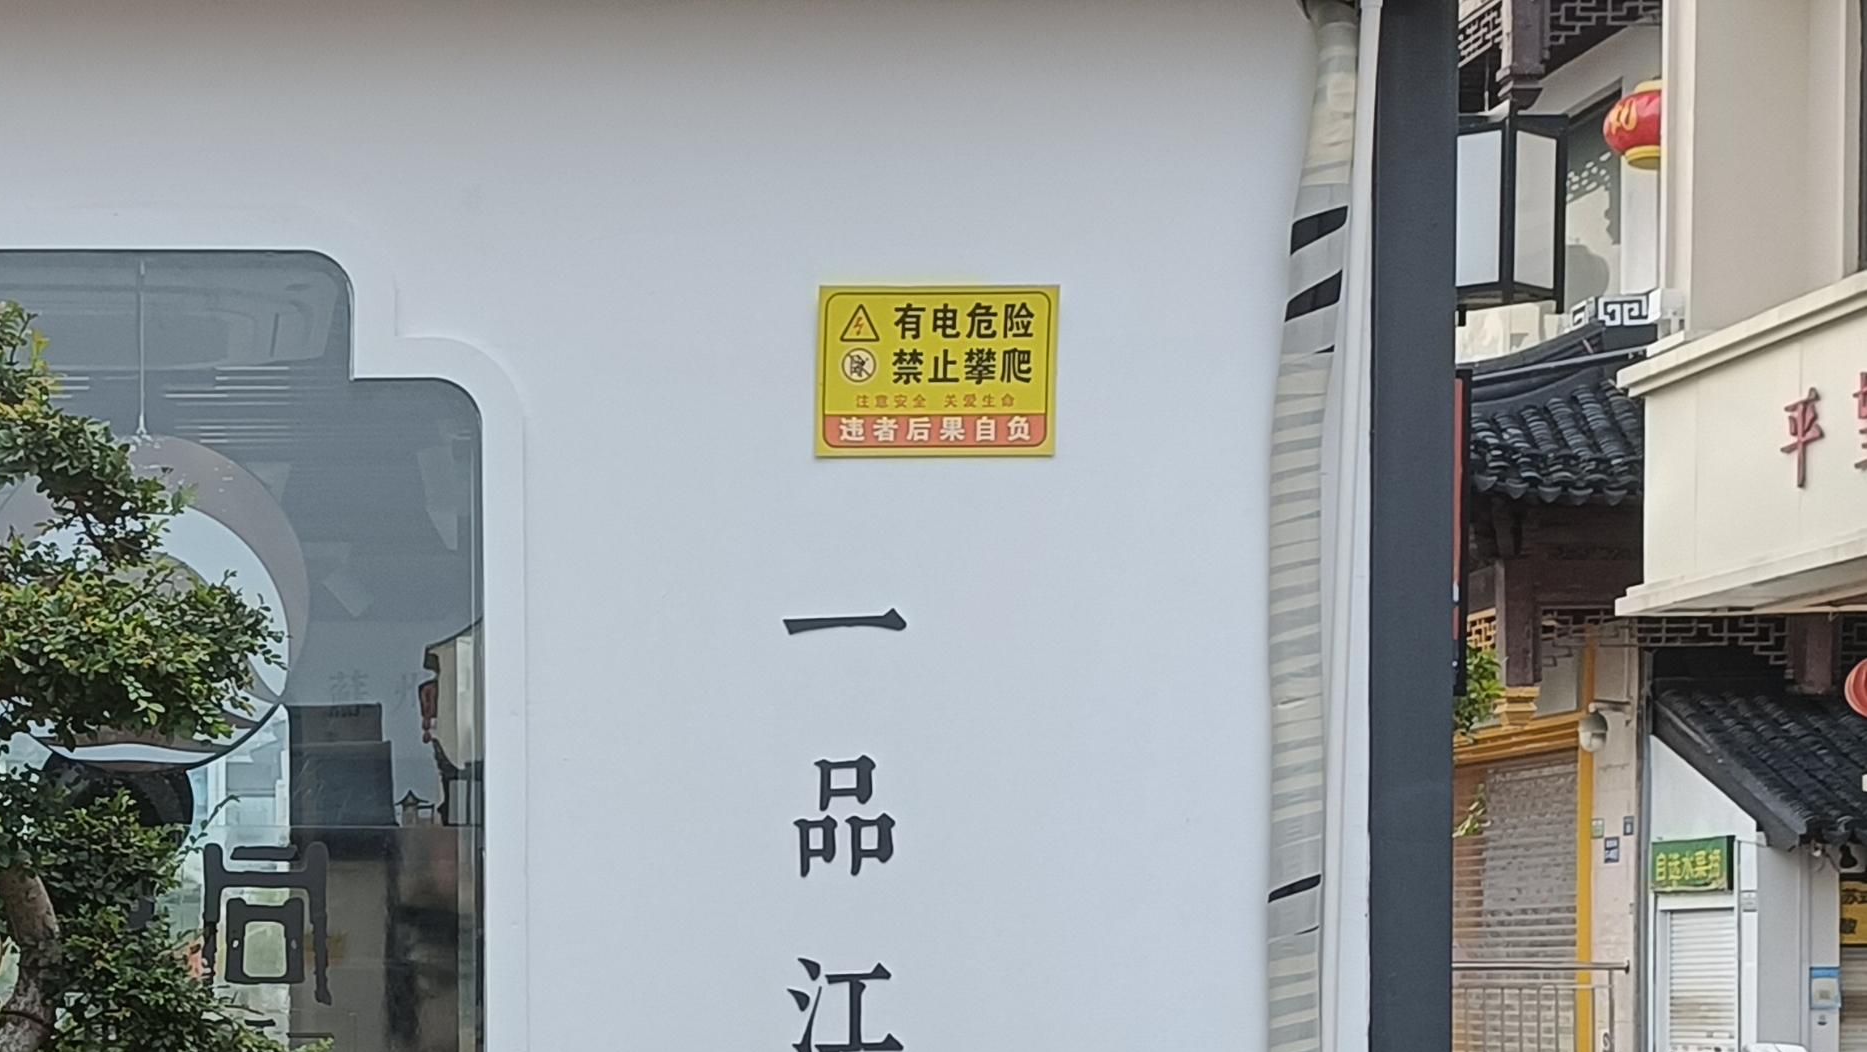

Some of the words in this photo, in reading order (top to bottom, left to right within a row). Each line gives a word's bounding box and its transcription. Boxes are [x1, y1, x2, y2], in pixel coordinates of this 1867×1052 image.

[893, 302, 1035, 340] 有电危险
[892, 347, 1032, 385] 禁止攀爬
[855, 393, 927, 408] 注意安全
[943, 393, 1016, 408] 关爱生命
[839, 416, 1031, 442] 违者后果自负
